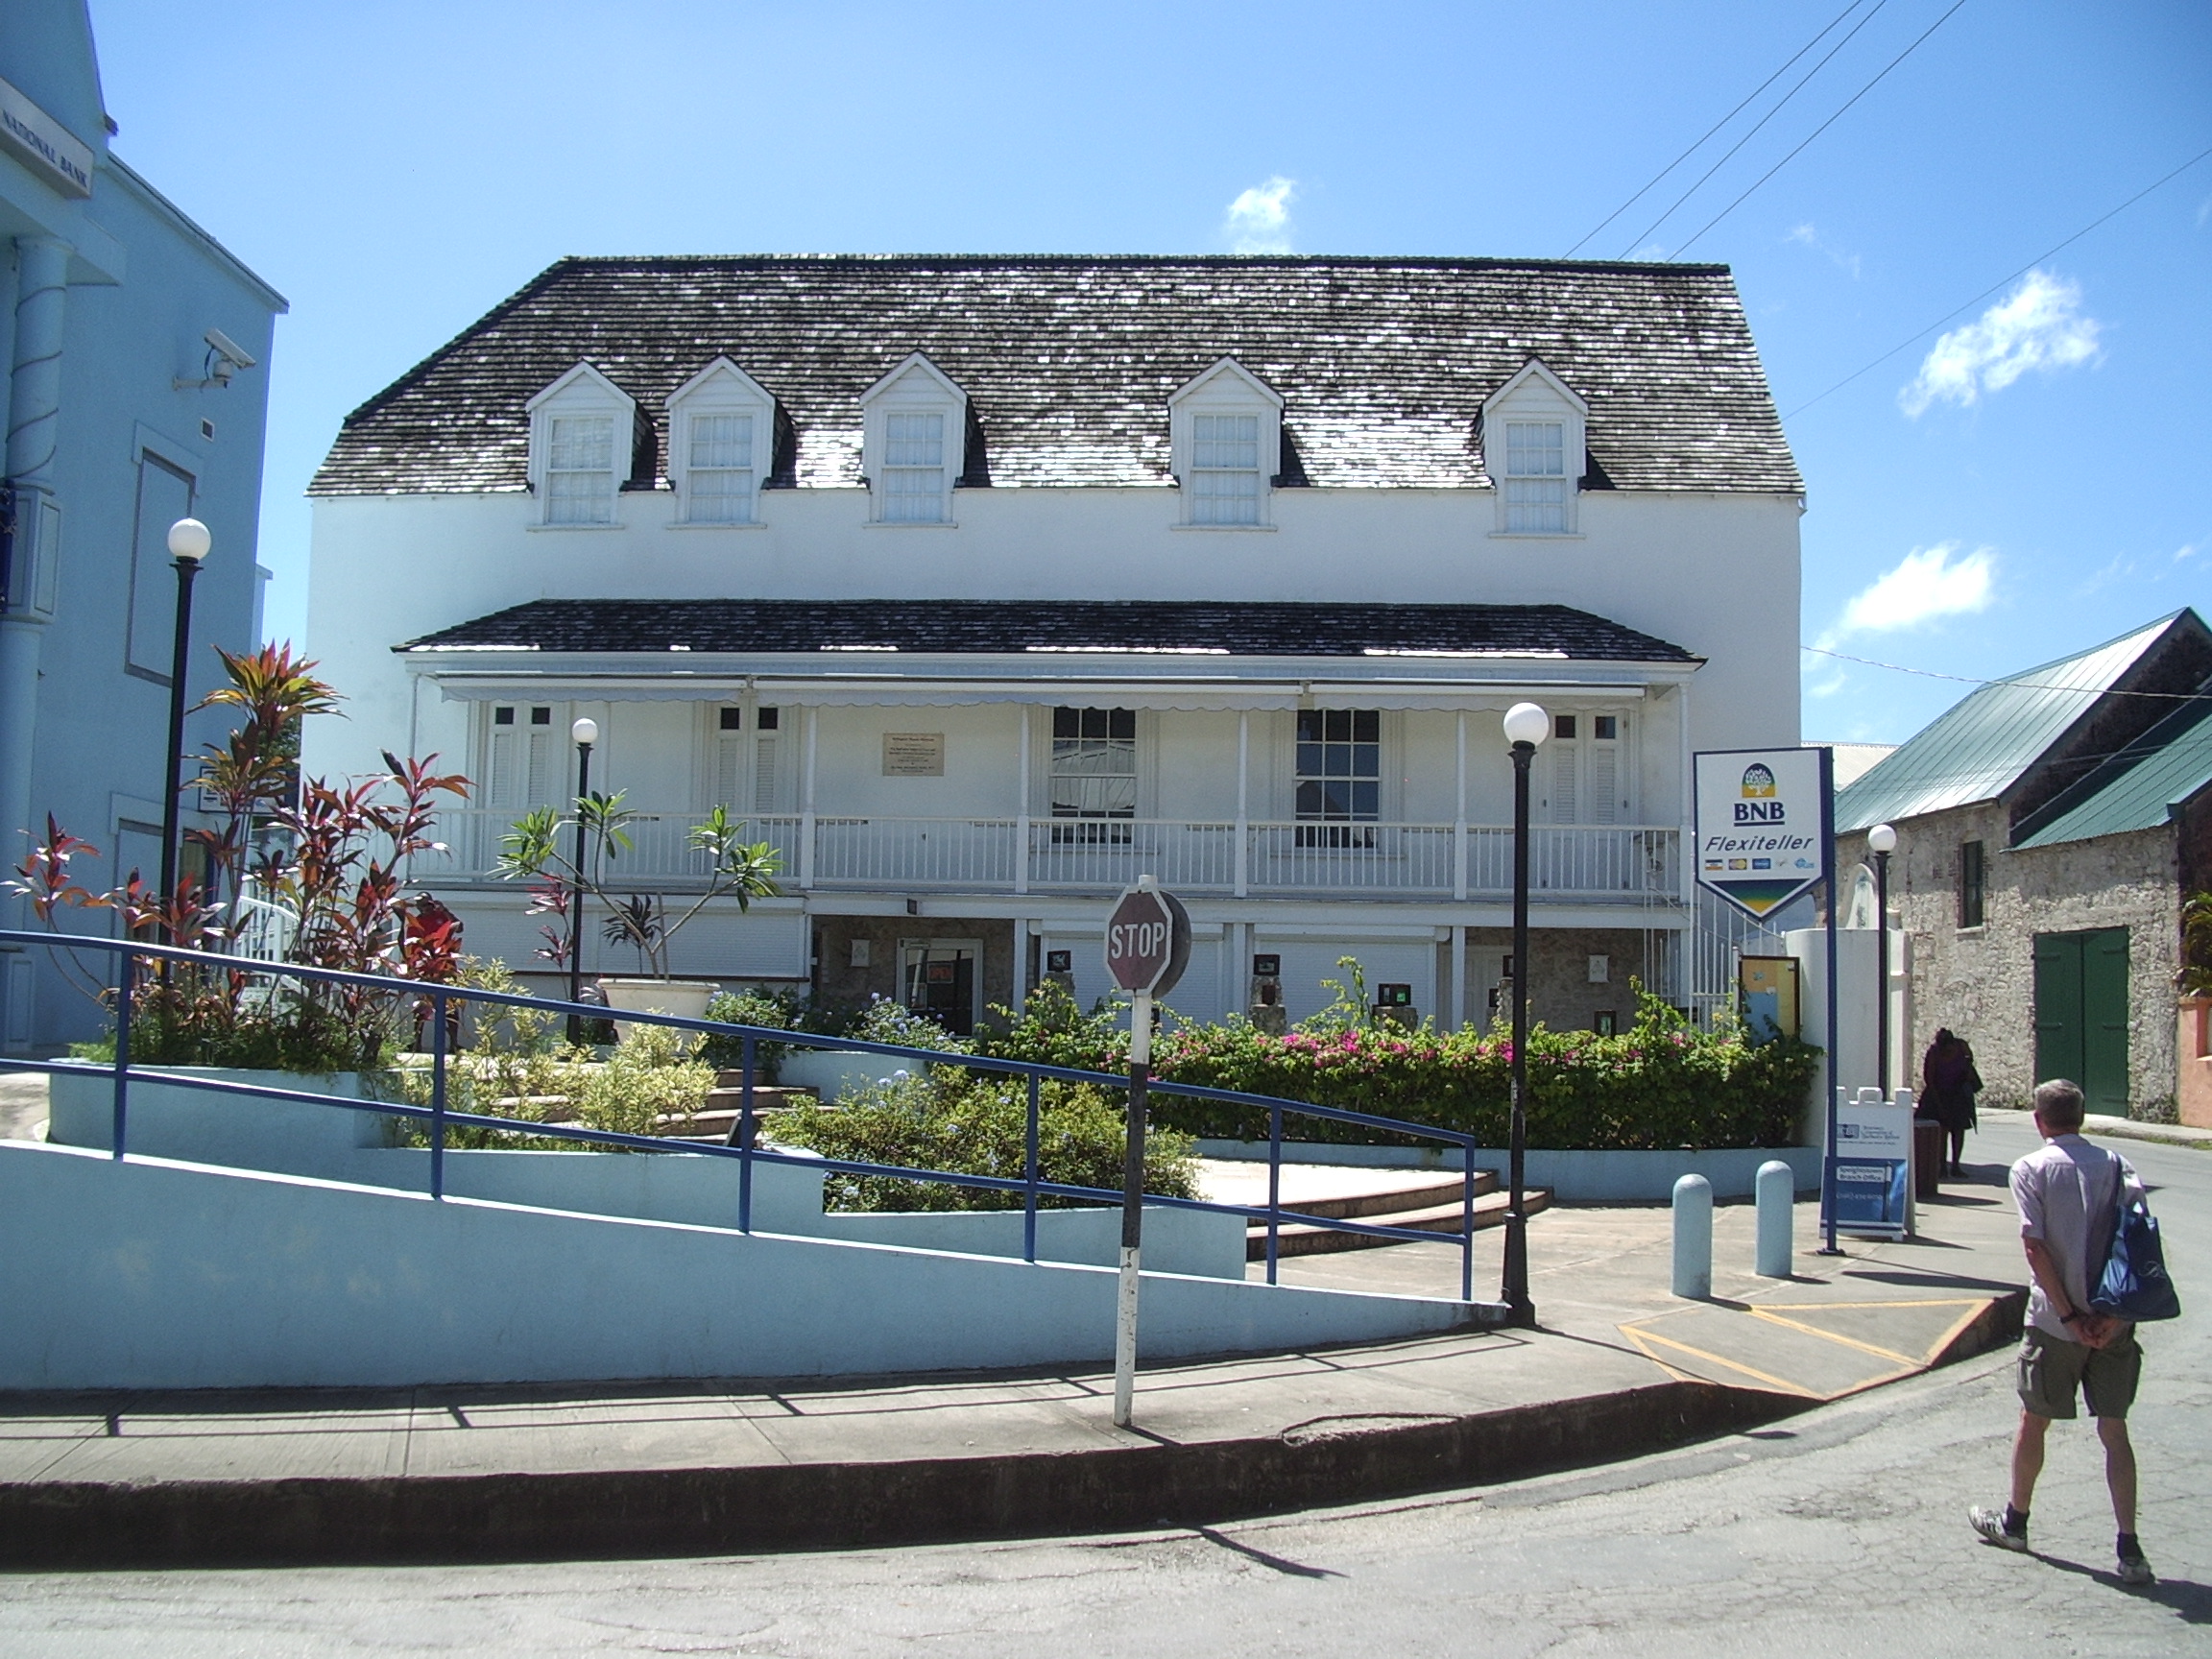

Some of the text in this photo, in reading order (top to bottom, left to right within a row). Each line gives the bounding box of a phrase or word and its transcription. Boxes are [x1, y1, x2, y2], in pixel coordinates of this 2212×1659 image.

[2, 108, 87, 189] NATIONAL BANK
[1733, 801, 1786, 822] BNB
[1704, 834, 1815, 853] Flexiteller
[1111, 922, 1166, 959] STOP
